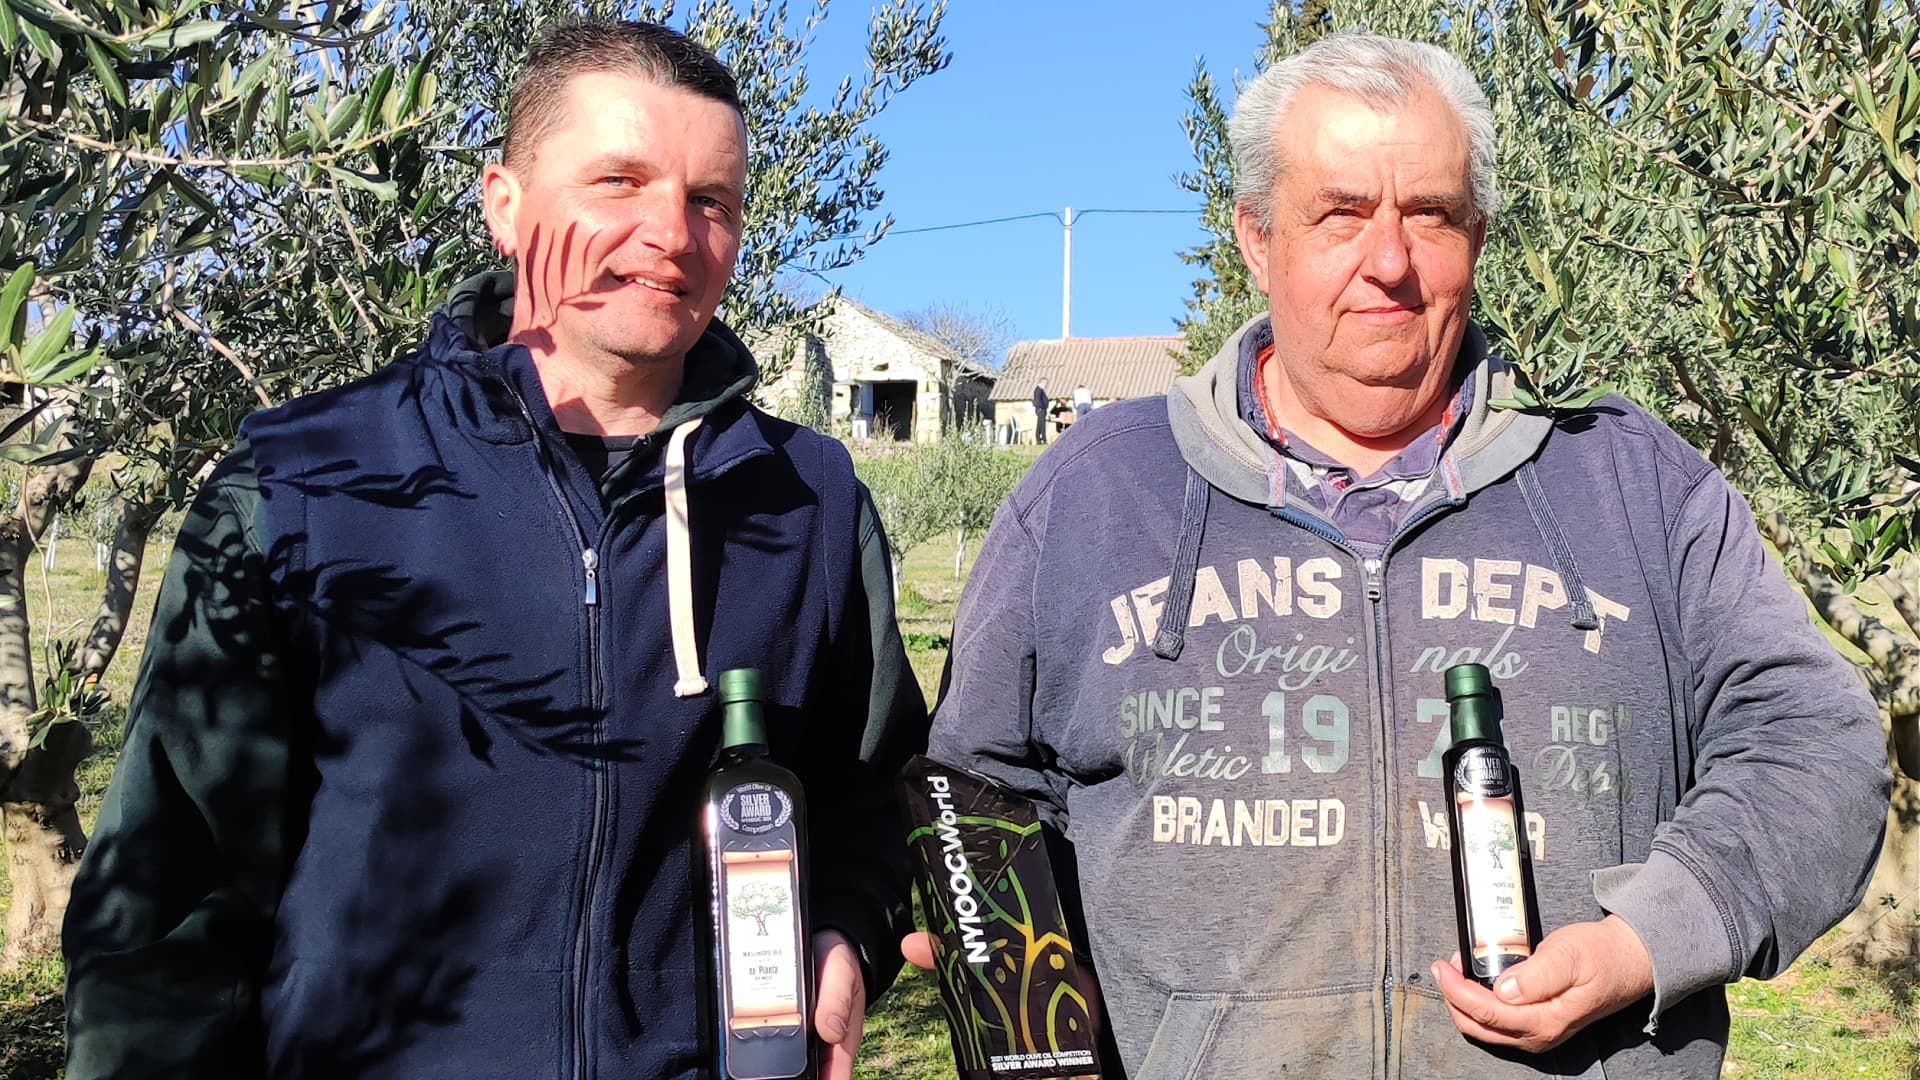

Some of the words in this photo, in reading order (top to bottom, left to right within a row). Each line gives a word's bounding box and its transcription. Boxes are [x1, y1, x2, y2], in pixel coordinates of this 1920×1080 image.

[1422, 557, 1631, 654] DEPT
[1120, 686, 1225, 739] SINCE
[1261, 691, 1351, 775] 19
[1478, 757, 1502, 770] ILVER
[1478, 768, 1503, 780] WARD
[740, 793, 770, 806] SILVER
[741, 805, 772, 818] AWARD
[1152, 795, 1346, 847] BRANDED
[1418, 801, 1546, 861] WR
[1053, 1050, 1091, 1058] COMPETITION
[992, 1061, 1022, 1071] SILVER
[1024, 1058, 1056, 1068] AWARD
[1057, 1056, 1094, 1066] WINNER
